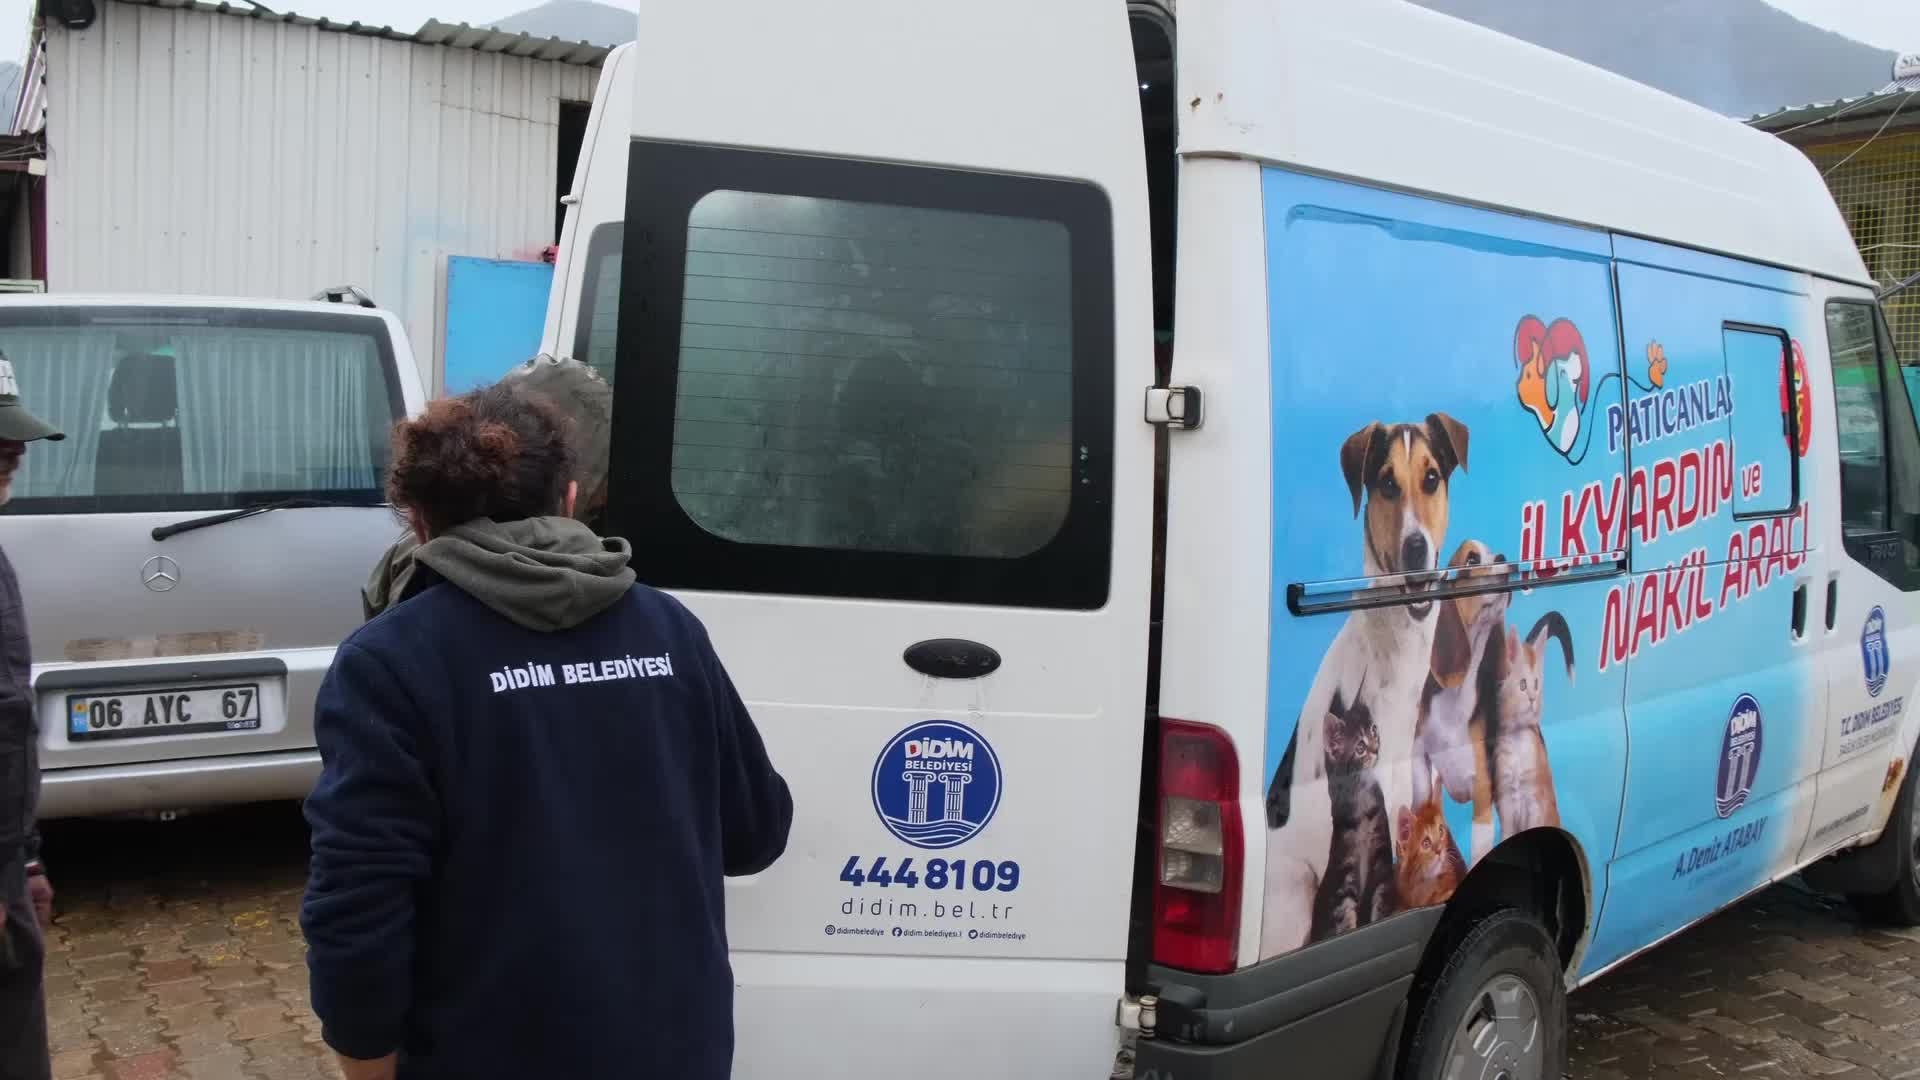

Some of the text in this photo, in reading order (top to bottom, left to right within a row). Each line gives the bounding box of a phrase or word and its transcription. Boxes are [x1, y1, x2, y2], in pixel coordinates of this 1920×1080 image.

[1742, 464, 1761, 497] ve
[1720, 501, 1809, 608] ARACI
[489, 652, 674, 693] DİDİM BELEDİYESİ
[89, 689, 253, 729] 06 AYC 67
[904, 736, 974, 760] DİDİM
[905, 760, 973, 772] BELEDİYESİ
